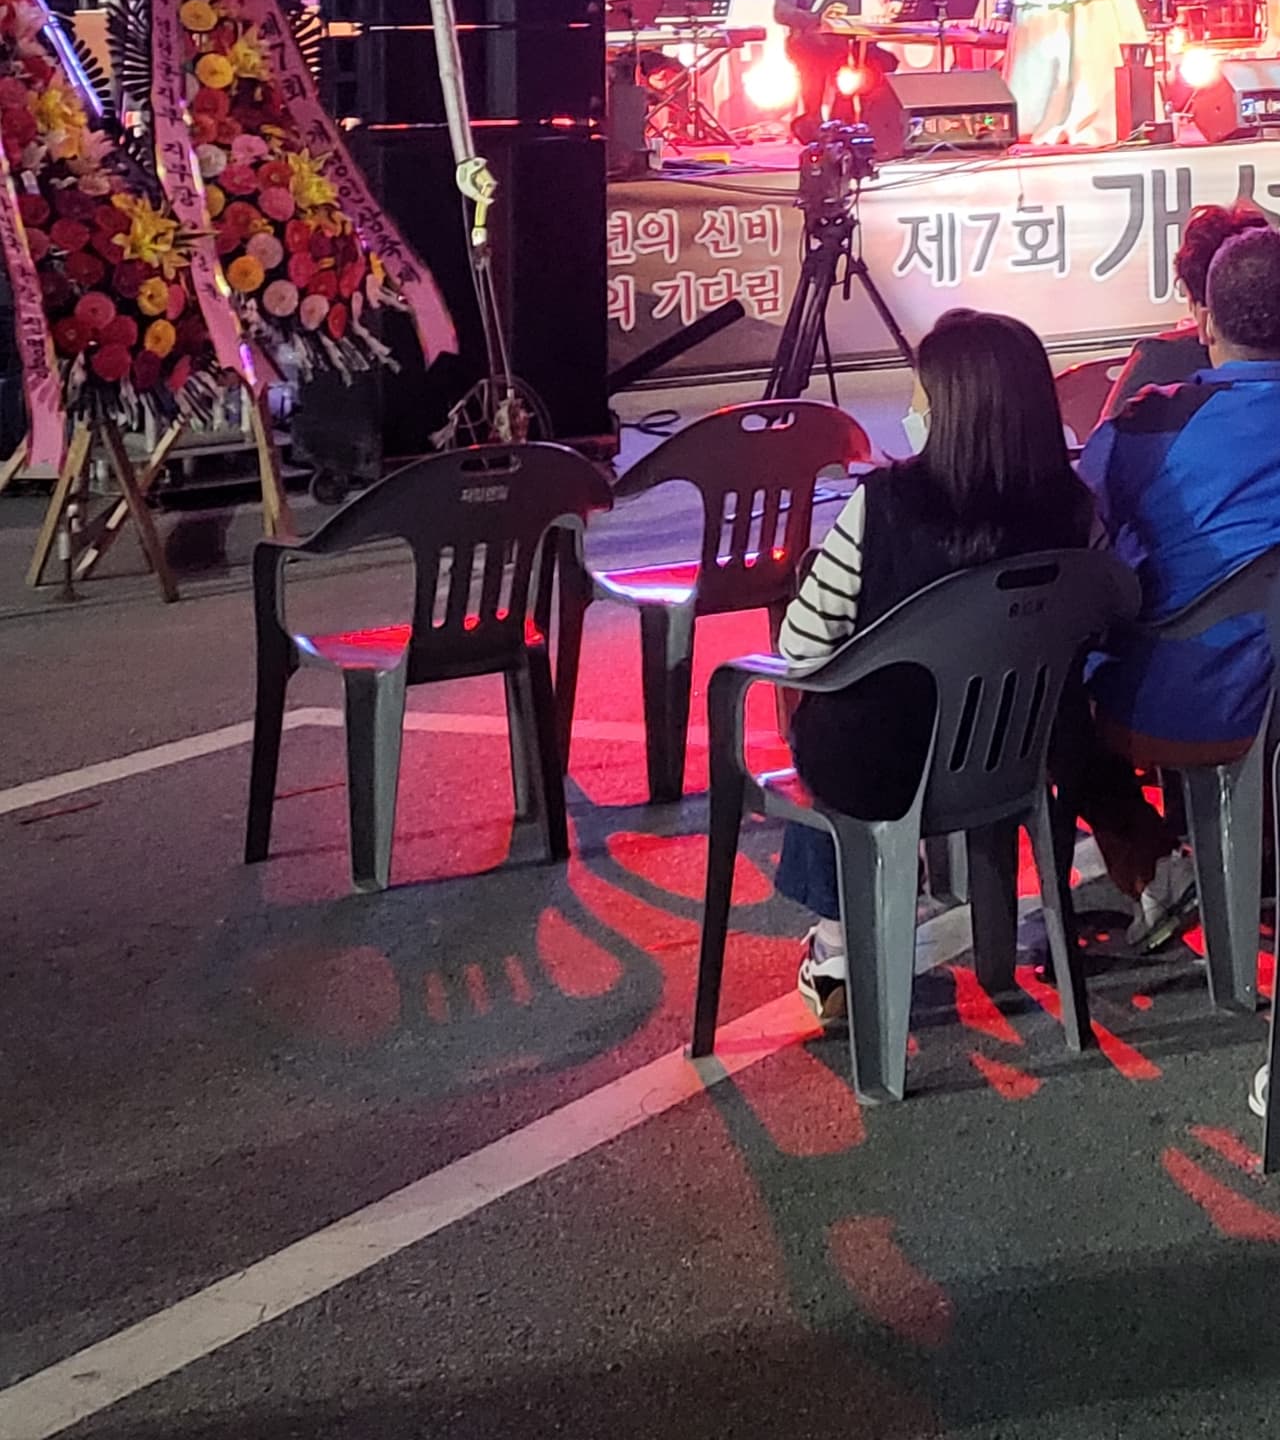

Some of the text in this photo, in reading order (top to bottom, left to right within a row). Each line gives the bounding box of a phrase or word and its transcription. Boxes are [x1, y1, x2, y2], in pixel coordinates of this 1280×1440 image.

[699, 208, 781, 255] 신비
[896, 205, 1065, 283] 제7회
[655, 269, 779, 323] 기다림
